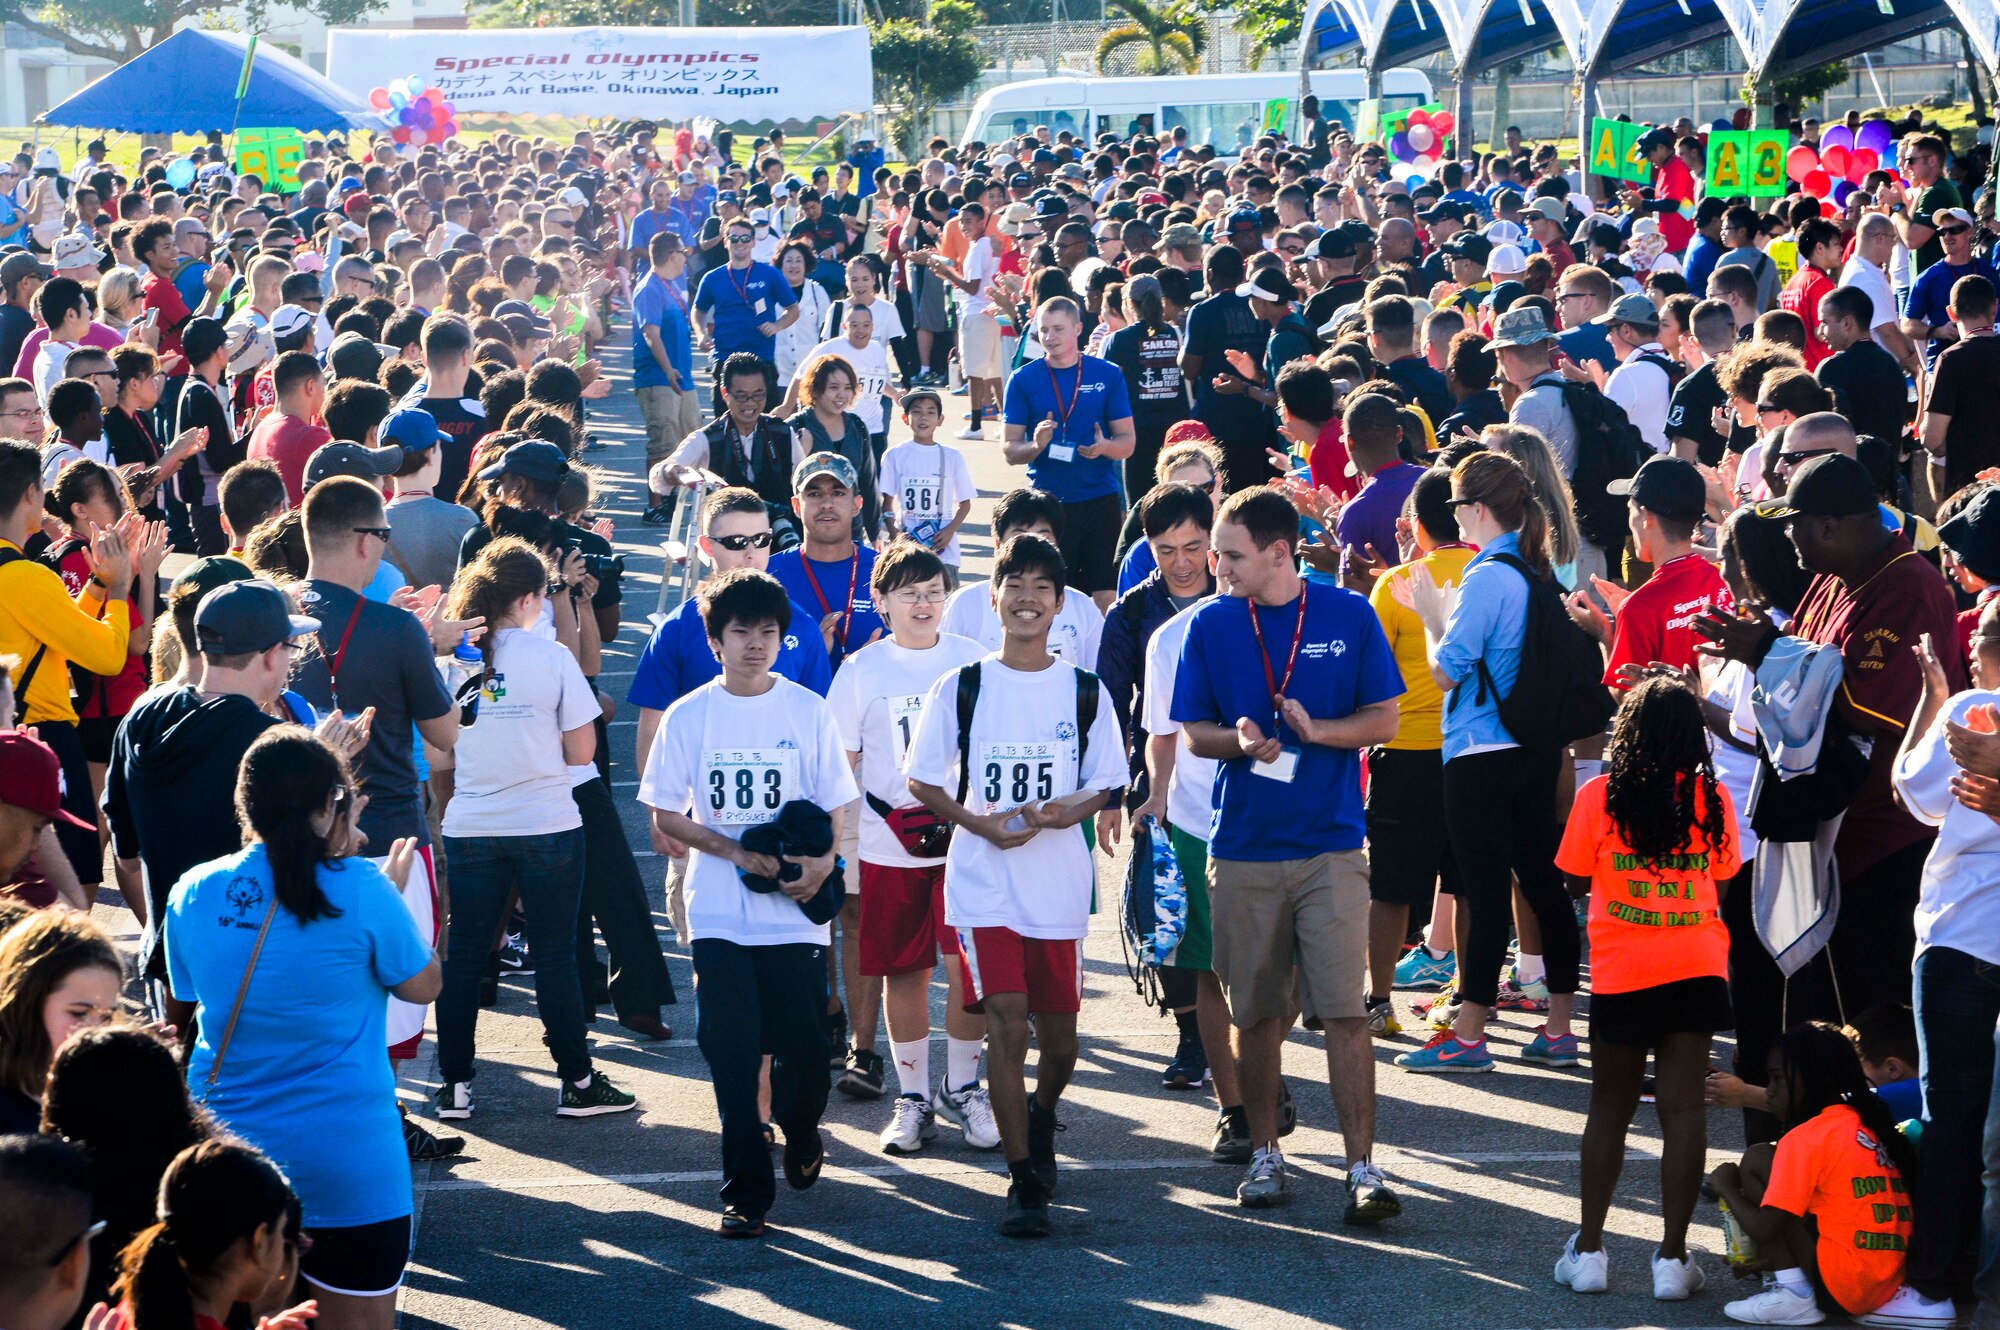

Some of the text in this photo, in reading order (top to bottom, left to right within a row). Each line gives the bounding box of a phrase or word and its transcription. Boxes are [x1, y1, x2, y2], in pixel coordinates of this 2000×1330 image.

[434, 51, 760, 73] Special Olympics
[435, 68, 760, 88] カデナ スペシャル オリンピックス
[444, 89, 496, 100] dena
[502, 86, 534, 95] Air
[712, 84, 779, 98] Japan
[1713, 141, 1782, 187] A3
[1142, 340, 1179, 350] SAILOR
[437, 421, 475, 435] UGBY
[1673, 594, 1711, 614] Special
[906, 696, 921, 708] F4
[732, 752, 744, 761] T3
[1006, 746, 1016, 756] T3
[1024, 746, 1033, 756] T6
[709, 769, 782, 810] 383
[985, 762, 1053, 803] 385
[727, 811, 766, 821] RYOSUKE
[1628, 880, 1696, 901] UP ON A
[1607, 900, 1662, 927] CHEER
[1872, 1203, 1895, 1224] UP
